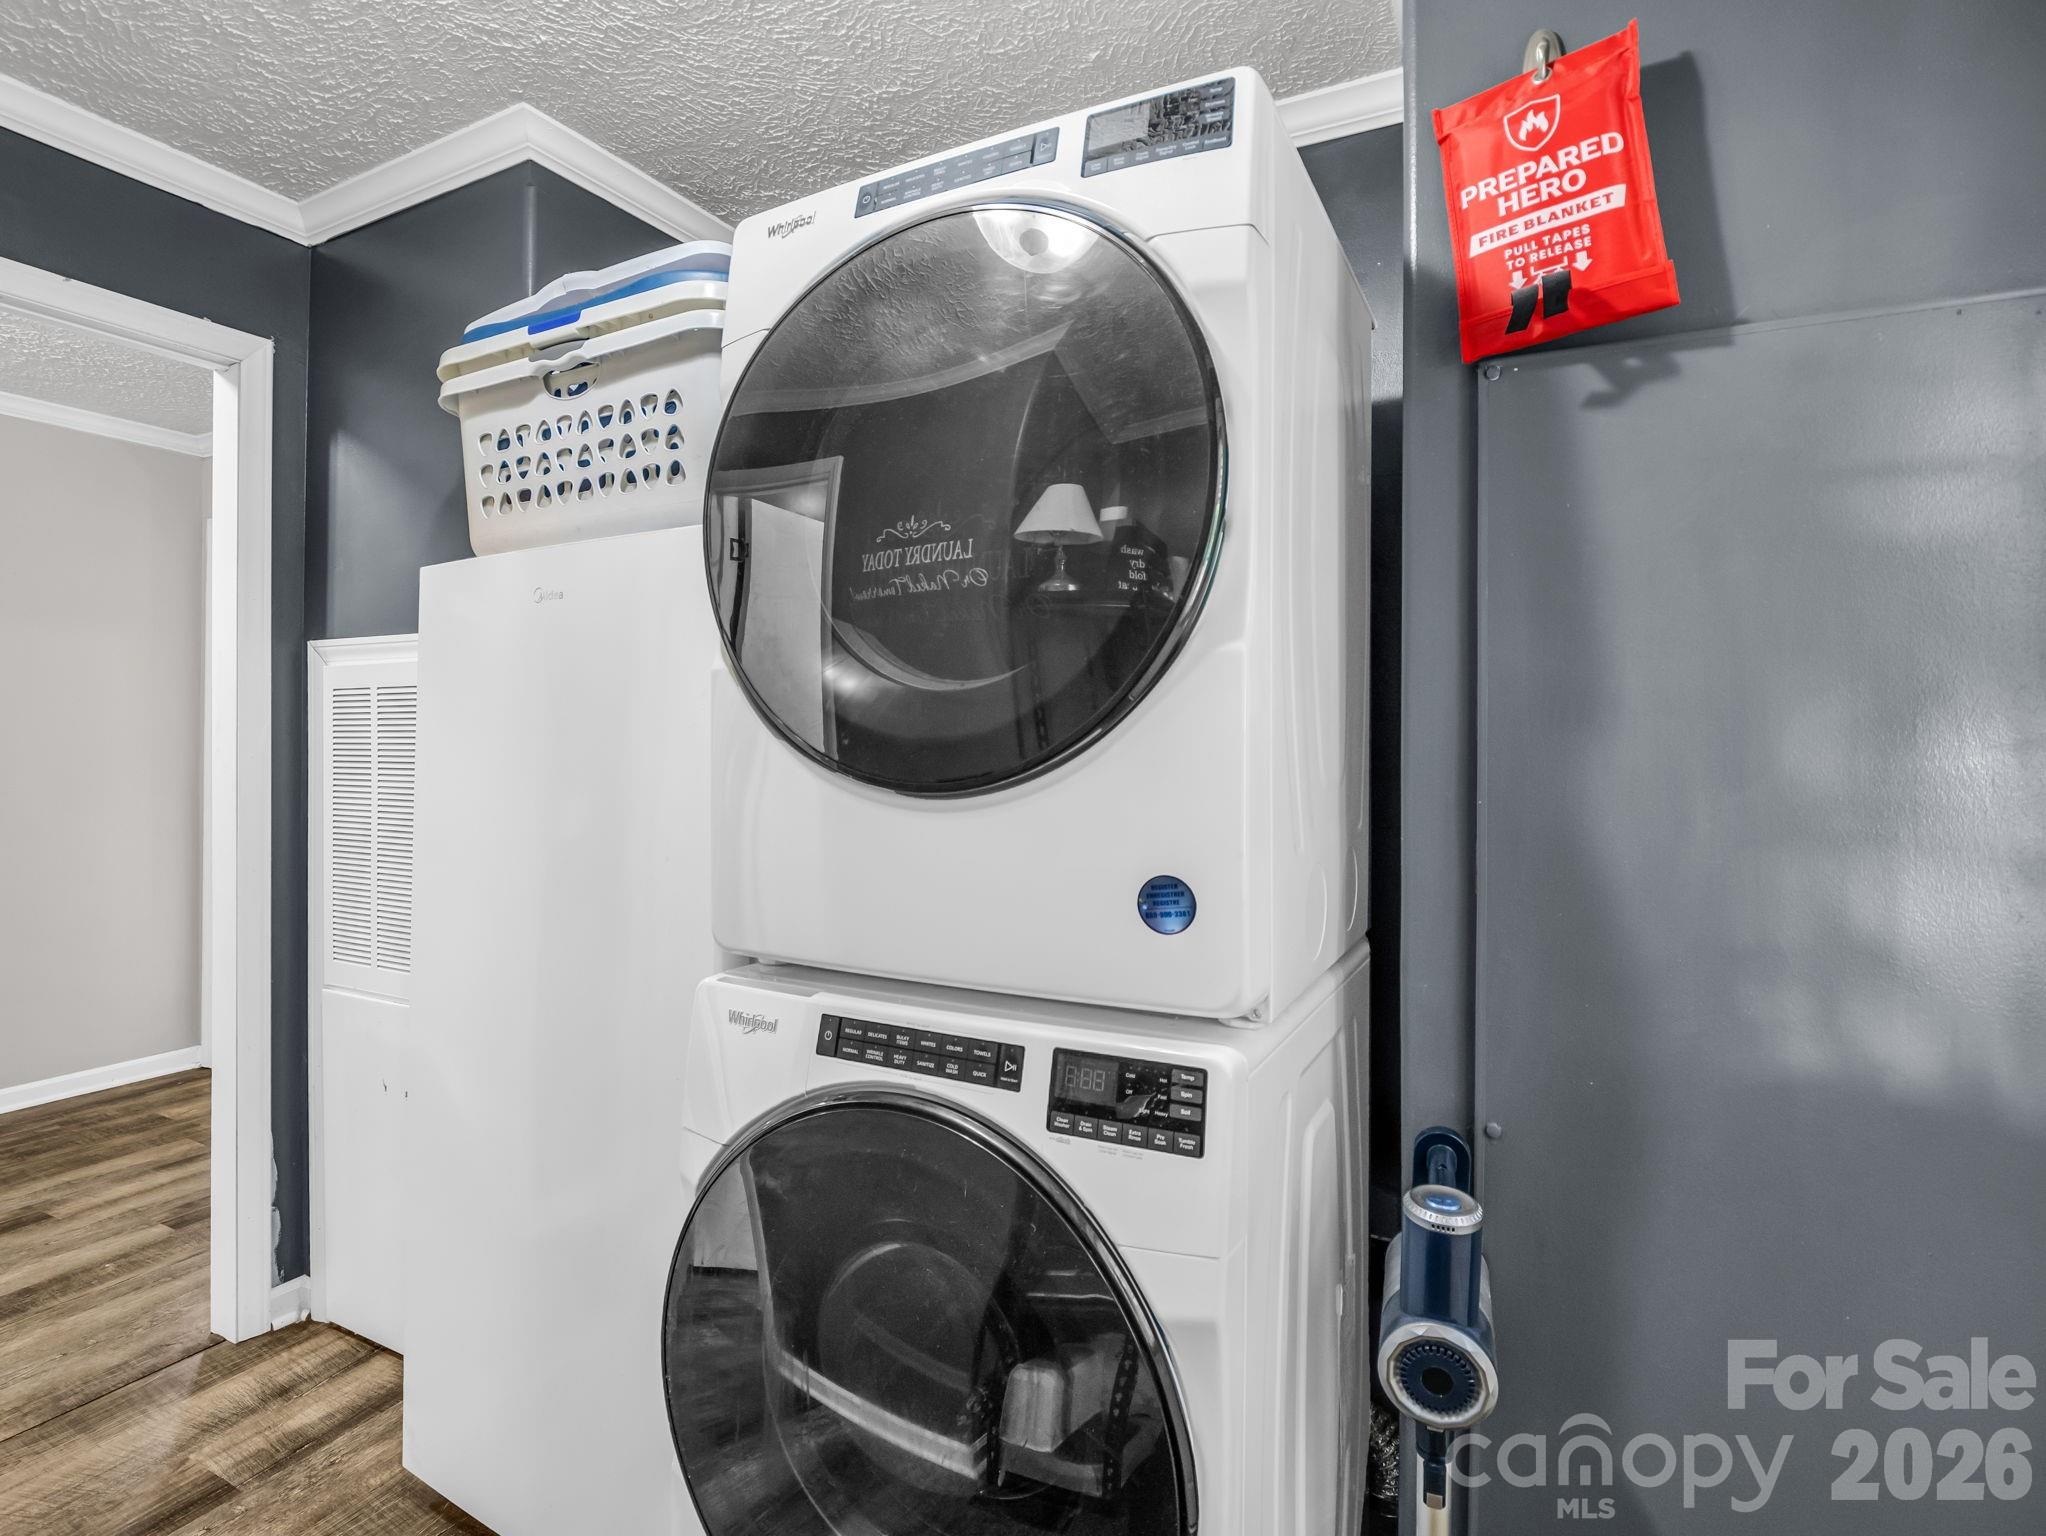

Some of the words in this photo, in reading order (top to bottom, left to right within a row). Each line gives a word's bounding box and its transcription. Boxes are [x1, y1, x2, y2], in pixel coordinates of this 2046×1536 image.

[1460, 132, 1624, 210] PREPARED
[1497, 168, 1587, 217] HERO
[767, 210, 817, 238] Whirlpool
[1478, 224, 1519, 248] FIRE
[1523, 191, 1614, 231] BLANKET
[1504, 241, 1538, 259] PULL
[1542, 223, 1591, 244] TAPES
[1506, 257, 1526, 270] TO
[1530, 236, 1592, 263] RELEASE
[728, 1009, 779, 1034] Whirlpool
[867, 1032, 888, 1040] DELICATES
[842, 1047, 859, 1055] NORMAL
[973, 1049, 991, 1057] TOWELS
[972, 1070, 987, 1078] QUICK
[1181, 1073, 1195, 1082] Temp
[1180, 1091, 1193, 1099] Spin
[1180, 1108, 1191, 1116] Soil
